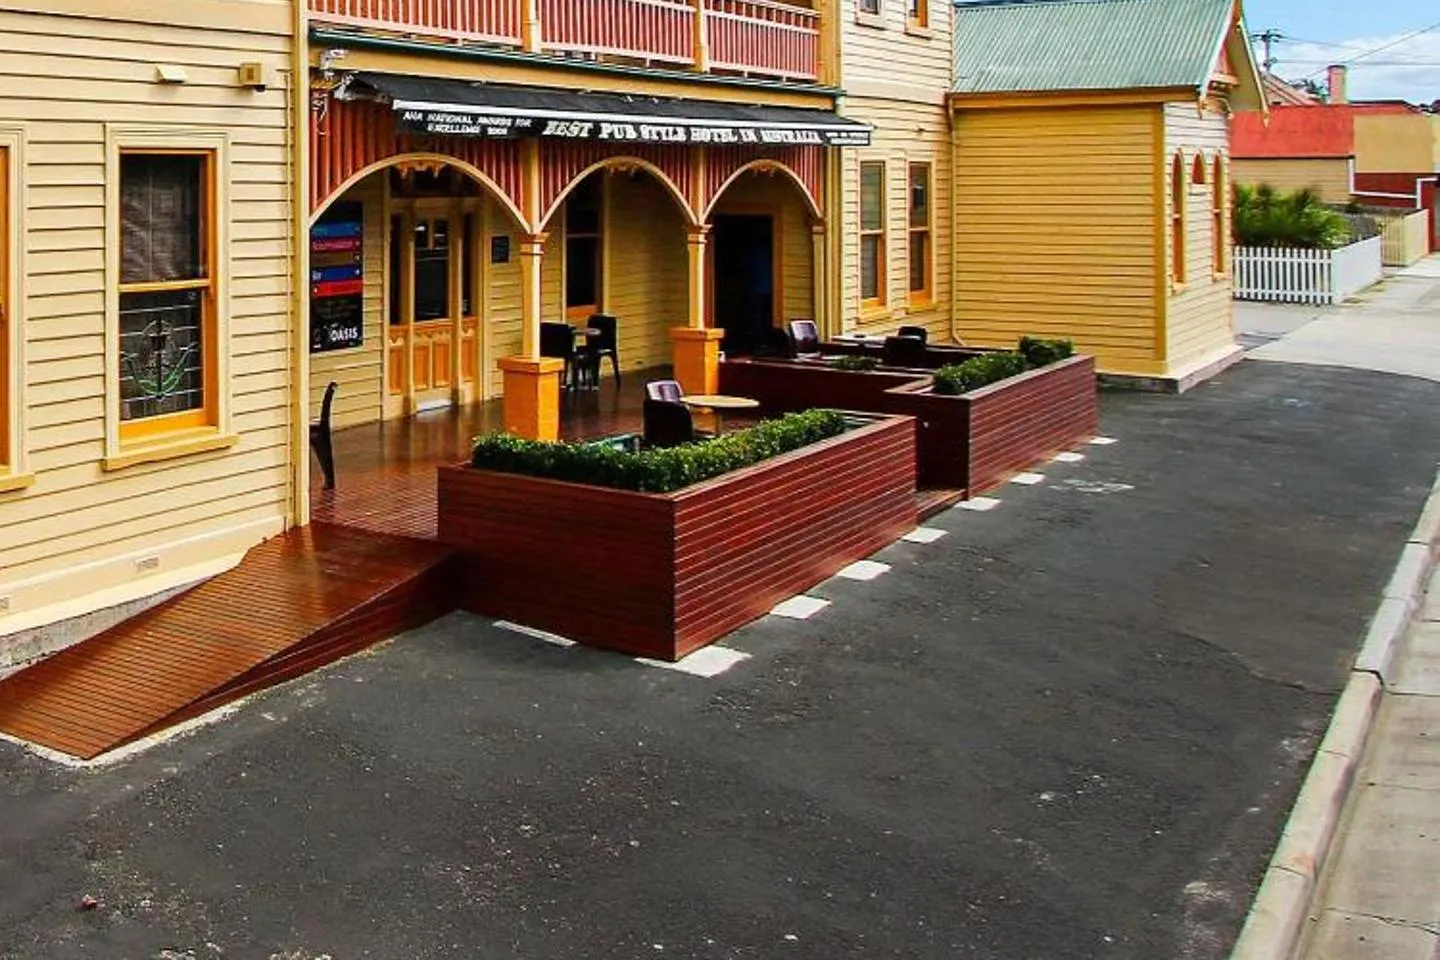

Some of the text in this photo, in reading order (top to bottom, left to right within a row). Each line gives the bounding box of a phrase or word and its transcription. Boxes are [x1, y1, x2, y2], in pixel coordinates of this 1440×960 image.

[427, 113, 473, 124] NATIONAL
[542, 120, 594, 138] BEST
[599, 121, 638, 140] PUB
[639, 124, 687, 142] STYLE
[690, 127, 738, 143] HOTEL
[329, 327, 359, 342] OASIS
